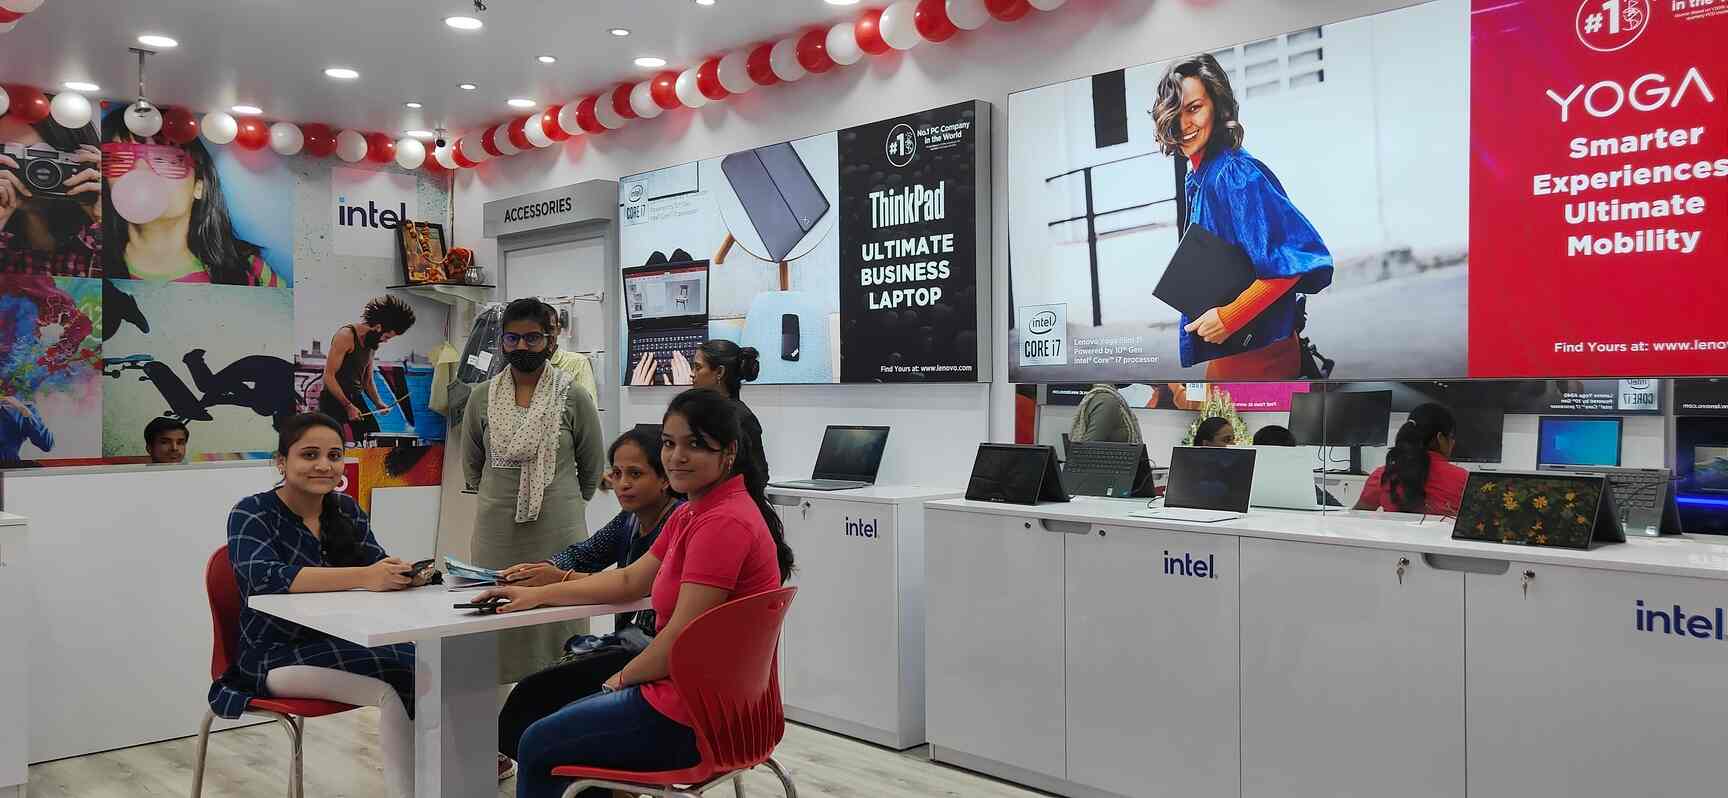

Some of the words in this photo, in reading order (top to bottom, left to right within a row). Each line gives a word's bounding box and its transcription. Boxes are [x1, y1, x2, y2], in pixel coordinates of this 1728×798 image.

[1584, 0, 1620, 34] #1
[1546, 67, 1714, 122] YOGA
[930, 126, 939, 135] PC
[940, 121, 970, 133] Company
[931, 135, 941, 143] the
[942, 130, 962, 141] World
[889, 133, 905, 156] #1
[1568, 125, 1706, 159] Smarter
[338, 196, 407, 230] intel
[504, 196, 572, 224] ACCESSORIES
[869, 181, 944, 228] ThinkPad
[1564, 194, 1706, 225] Ultimate
[862, 233, 953, 261] ULTIMATE
[1567, 228, 1702, 257] Mobility
[861, 260, 950, 286] BUSINESS
[869, 287, 942, 310] LAPTOP
[1032, 316, 1053, 328] intel
[1024, 339, 1049, 357] CORE
[1051, 339, 1061, 356] i7
[1074, 347, 1103, 355] Powered
[1104, 346, 1113, 356] by
[1128, 345, 1143, 354] Gen
[1554, 342, 1584, 352] Find
[1587, 341, 1627, 352] Yours
[1630, 341, 1648, 352] at:
[880, 365, 893, 373] Find
[920, 364, 973, 372] www.lenovo.com
[845, 517, 878, 539] intel
[1164, 551, 1216, 579] intel
[1636, 600, 1723, 640] intel
